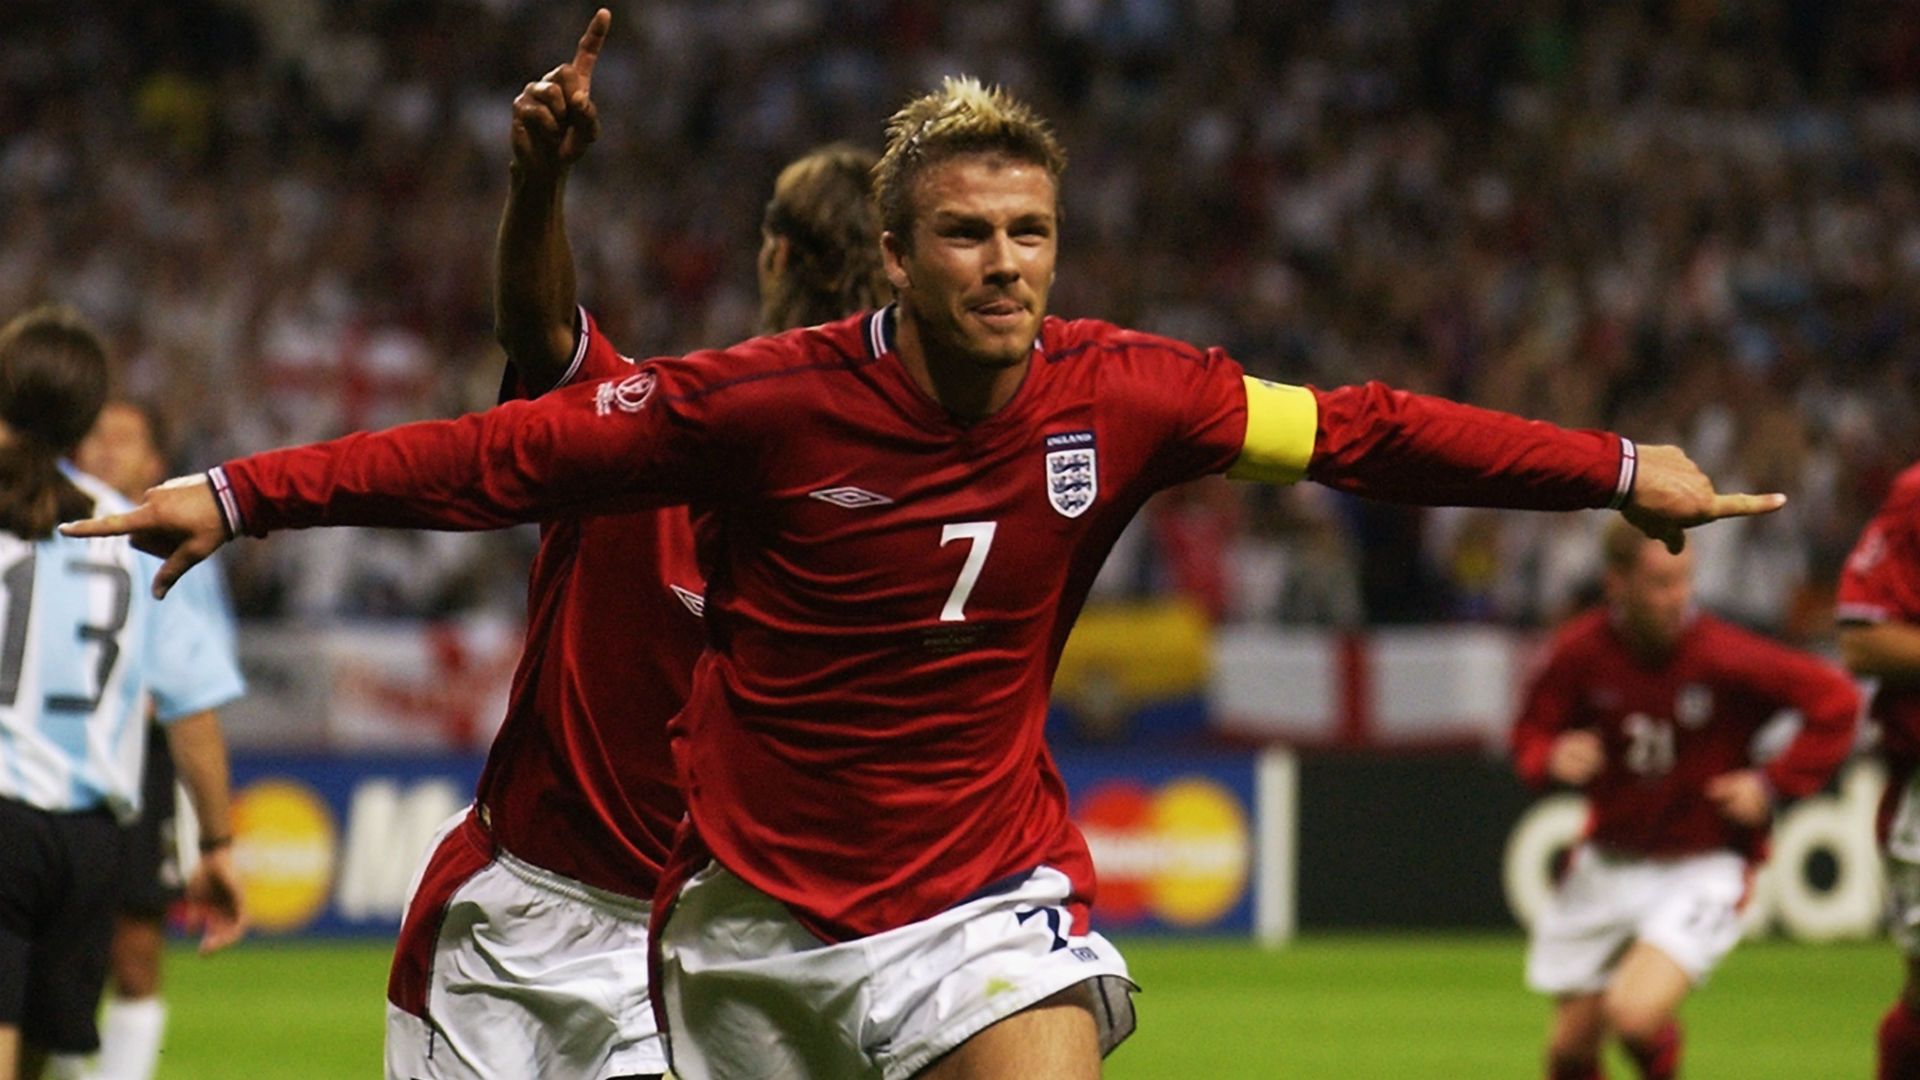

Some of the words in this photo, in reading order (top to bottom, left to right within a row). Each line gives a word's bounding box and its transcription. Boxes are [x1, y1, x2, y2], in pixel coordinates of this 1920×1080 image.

[1046, 433, 1092, 446] ENGLAND
[939, 520, 998, 622] 7
[1, 548, 132, 712] 13
[1015, 905, 1068, 953] 7
